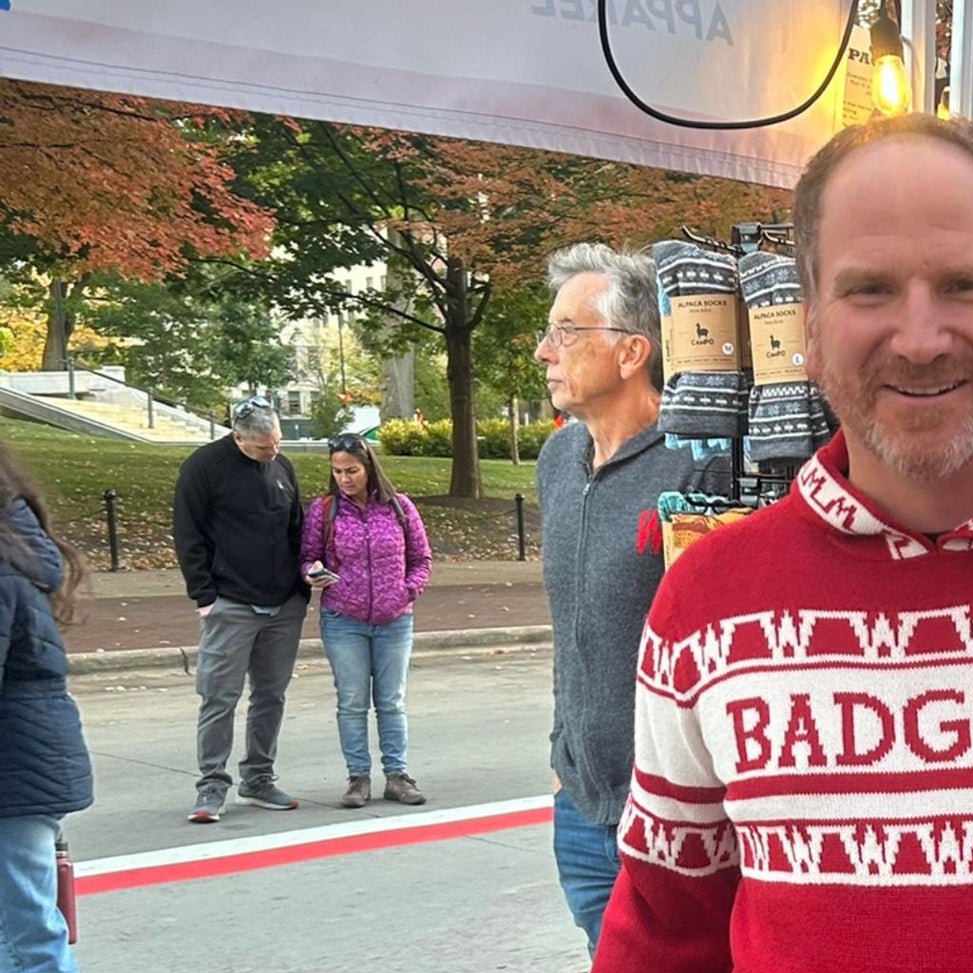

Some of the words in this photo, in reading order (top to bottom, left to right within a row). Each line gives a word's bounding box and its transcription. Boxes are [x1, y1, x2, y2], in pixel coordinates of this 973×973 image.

[678, 300, 702, 308] ALPACA
[704, 299, 728, 307] SOCKS
[754, 311, 775, 320] ALPACA
[776, 309, 796, 317] SOCKS
[691, 337, 715, 346] CAMPO
[766, 350, 786, 358] CAMPO
